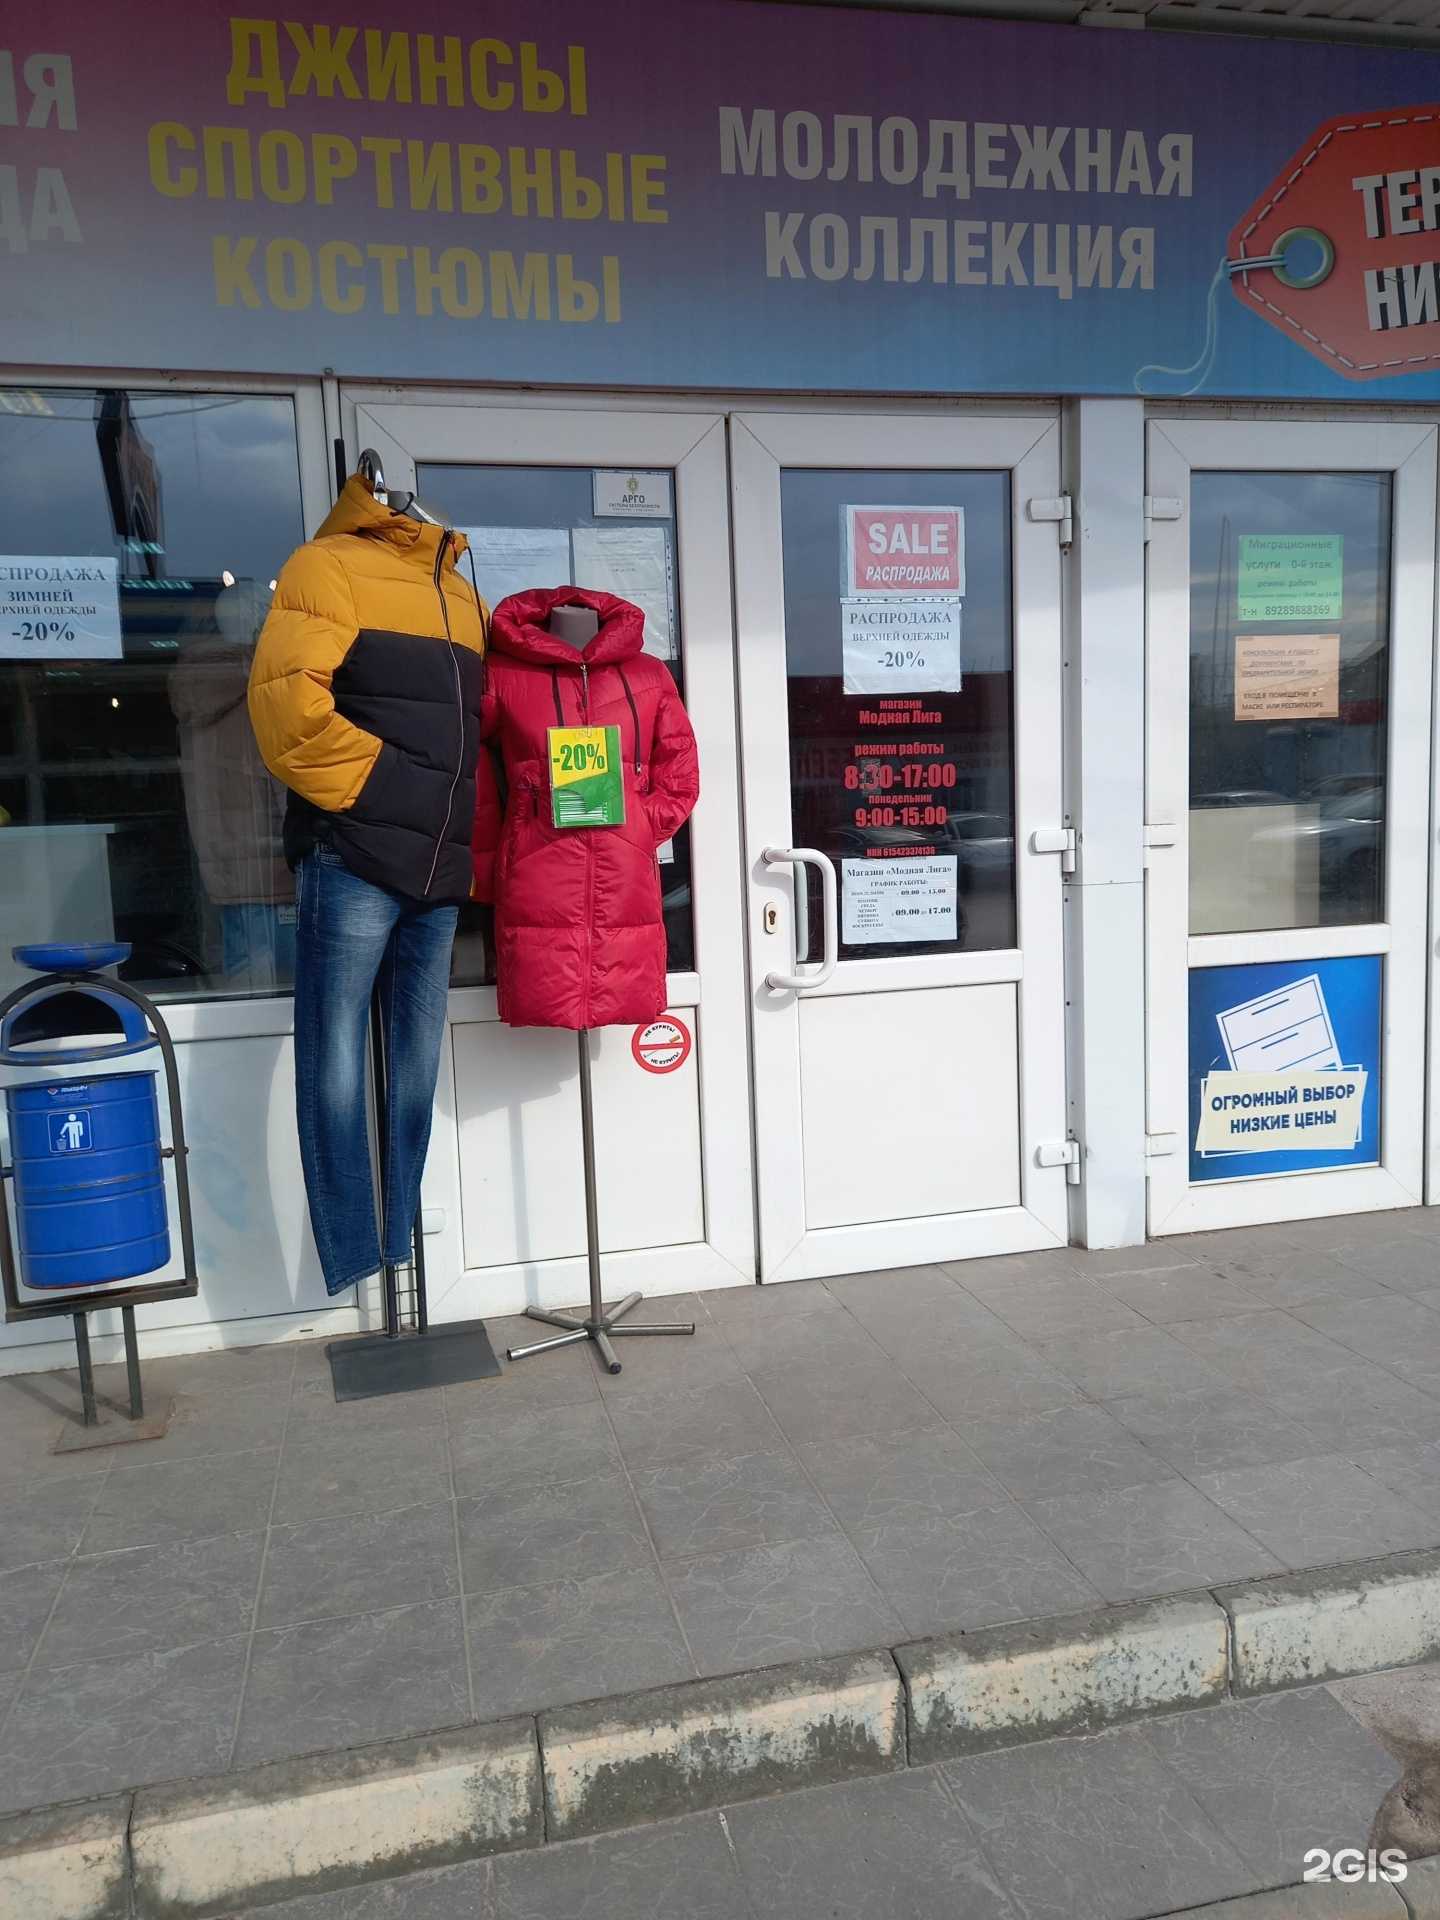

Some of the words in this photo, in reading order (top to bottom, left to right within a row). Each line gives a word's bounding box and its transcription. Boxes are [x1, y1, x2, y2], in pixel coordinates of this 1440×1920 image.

[226, 17, 588, 116] ДЖИНСЫ
[718, 106, 1193, 199] МОЛОДЕЖНАЯ
[147, 122, 669, 224] СПОРТИВНЫЕ
[764, 211, 1155, 300] КОЛЛЕКЦИЯ
[212, 235, 622, 323] КОСТЮМЫ
[622, 495, 645, 503] АРГО
[868, 522, 949, 555] SALE
[865, 565, 950, 585] РАСПРОДАЖА
[7, 588, 74, 602] ЗИМНЕЙ
[44, 606, 97, 616] ОДЕЖДЫ
[850, 612, 952, 625] РАСПРОДАЖА
[11, 621, 76, 641] -20%
[852, 631, 900, 642] ВЕРХНЕЙ
[902, 631, 950, 641] ОДЕЖДЫ
[877, 651, 926, 668] -20%
[879, 699, 923, 709] магазин
[858, 710, 910, 726] Модная
[911, 711, 943, 724] Лига
[553, 743, 605, 771] -20%
[855, 743, 897, 757] режим
[899, 742, 945, 755] работы
[855, 805, 948, 828] 9:00-15:00
[848, 868, 884, 877] Магазин
[1211, 1086, 1298, 1111] ОГРОМНЫЙ
[1303, 1084, 1356, 1103] ВЫБОР
[1230, 1113, 1290, 1134] НИЗКИЕ
[1294, 1110, 1337, 1129] ЦЕНЫ
